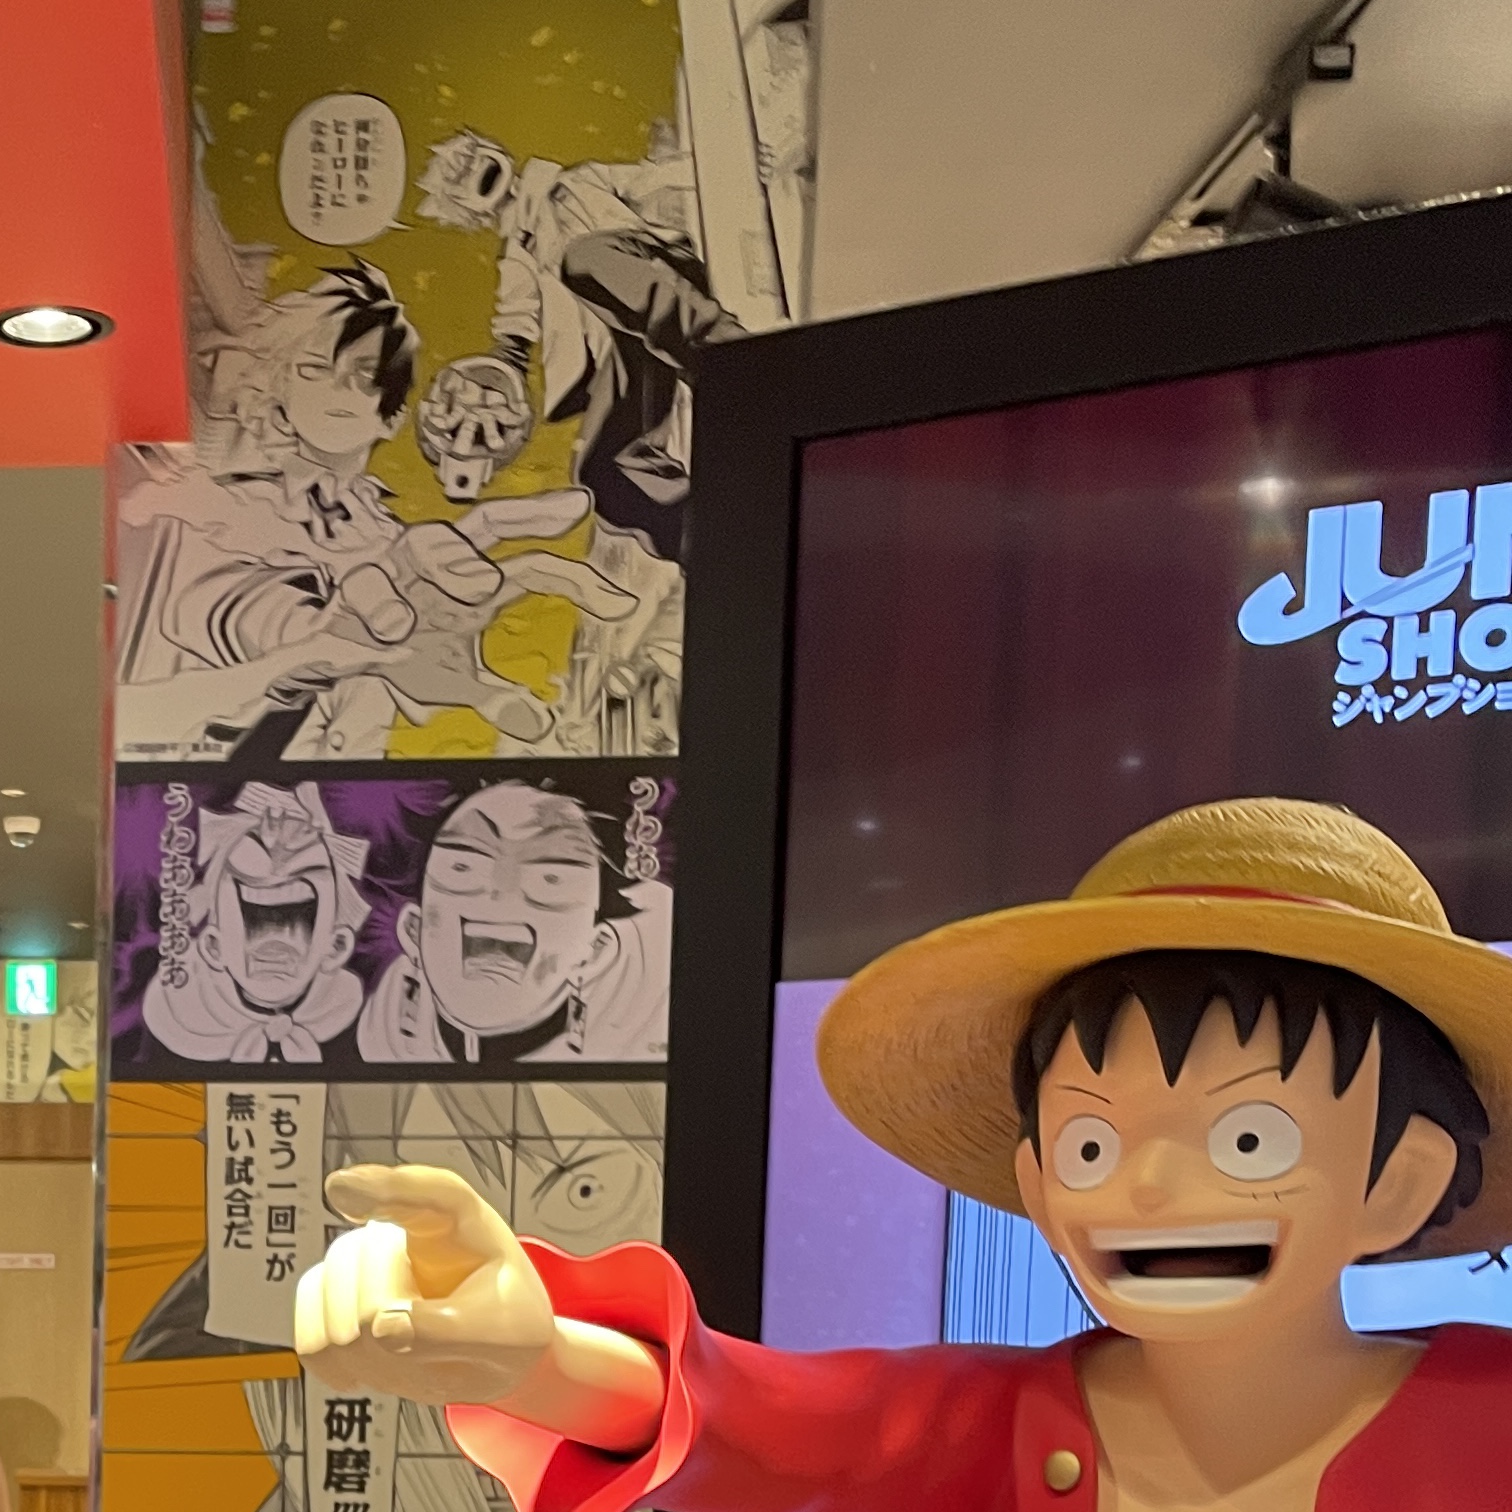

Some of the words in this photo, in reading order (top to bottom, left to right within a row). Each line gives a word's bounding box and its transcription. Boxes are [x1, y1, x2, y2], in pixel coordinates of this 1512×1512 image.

[1334, 603, 1512, 687] SHO
[223, 1091, 256, 1250] 無い試合だ
